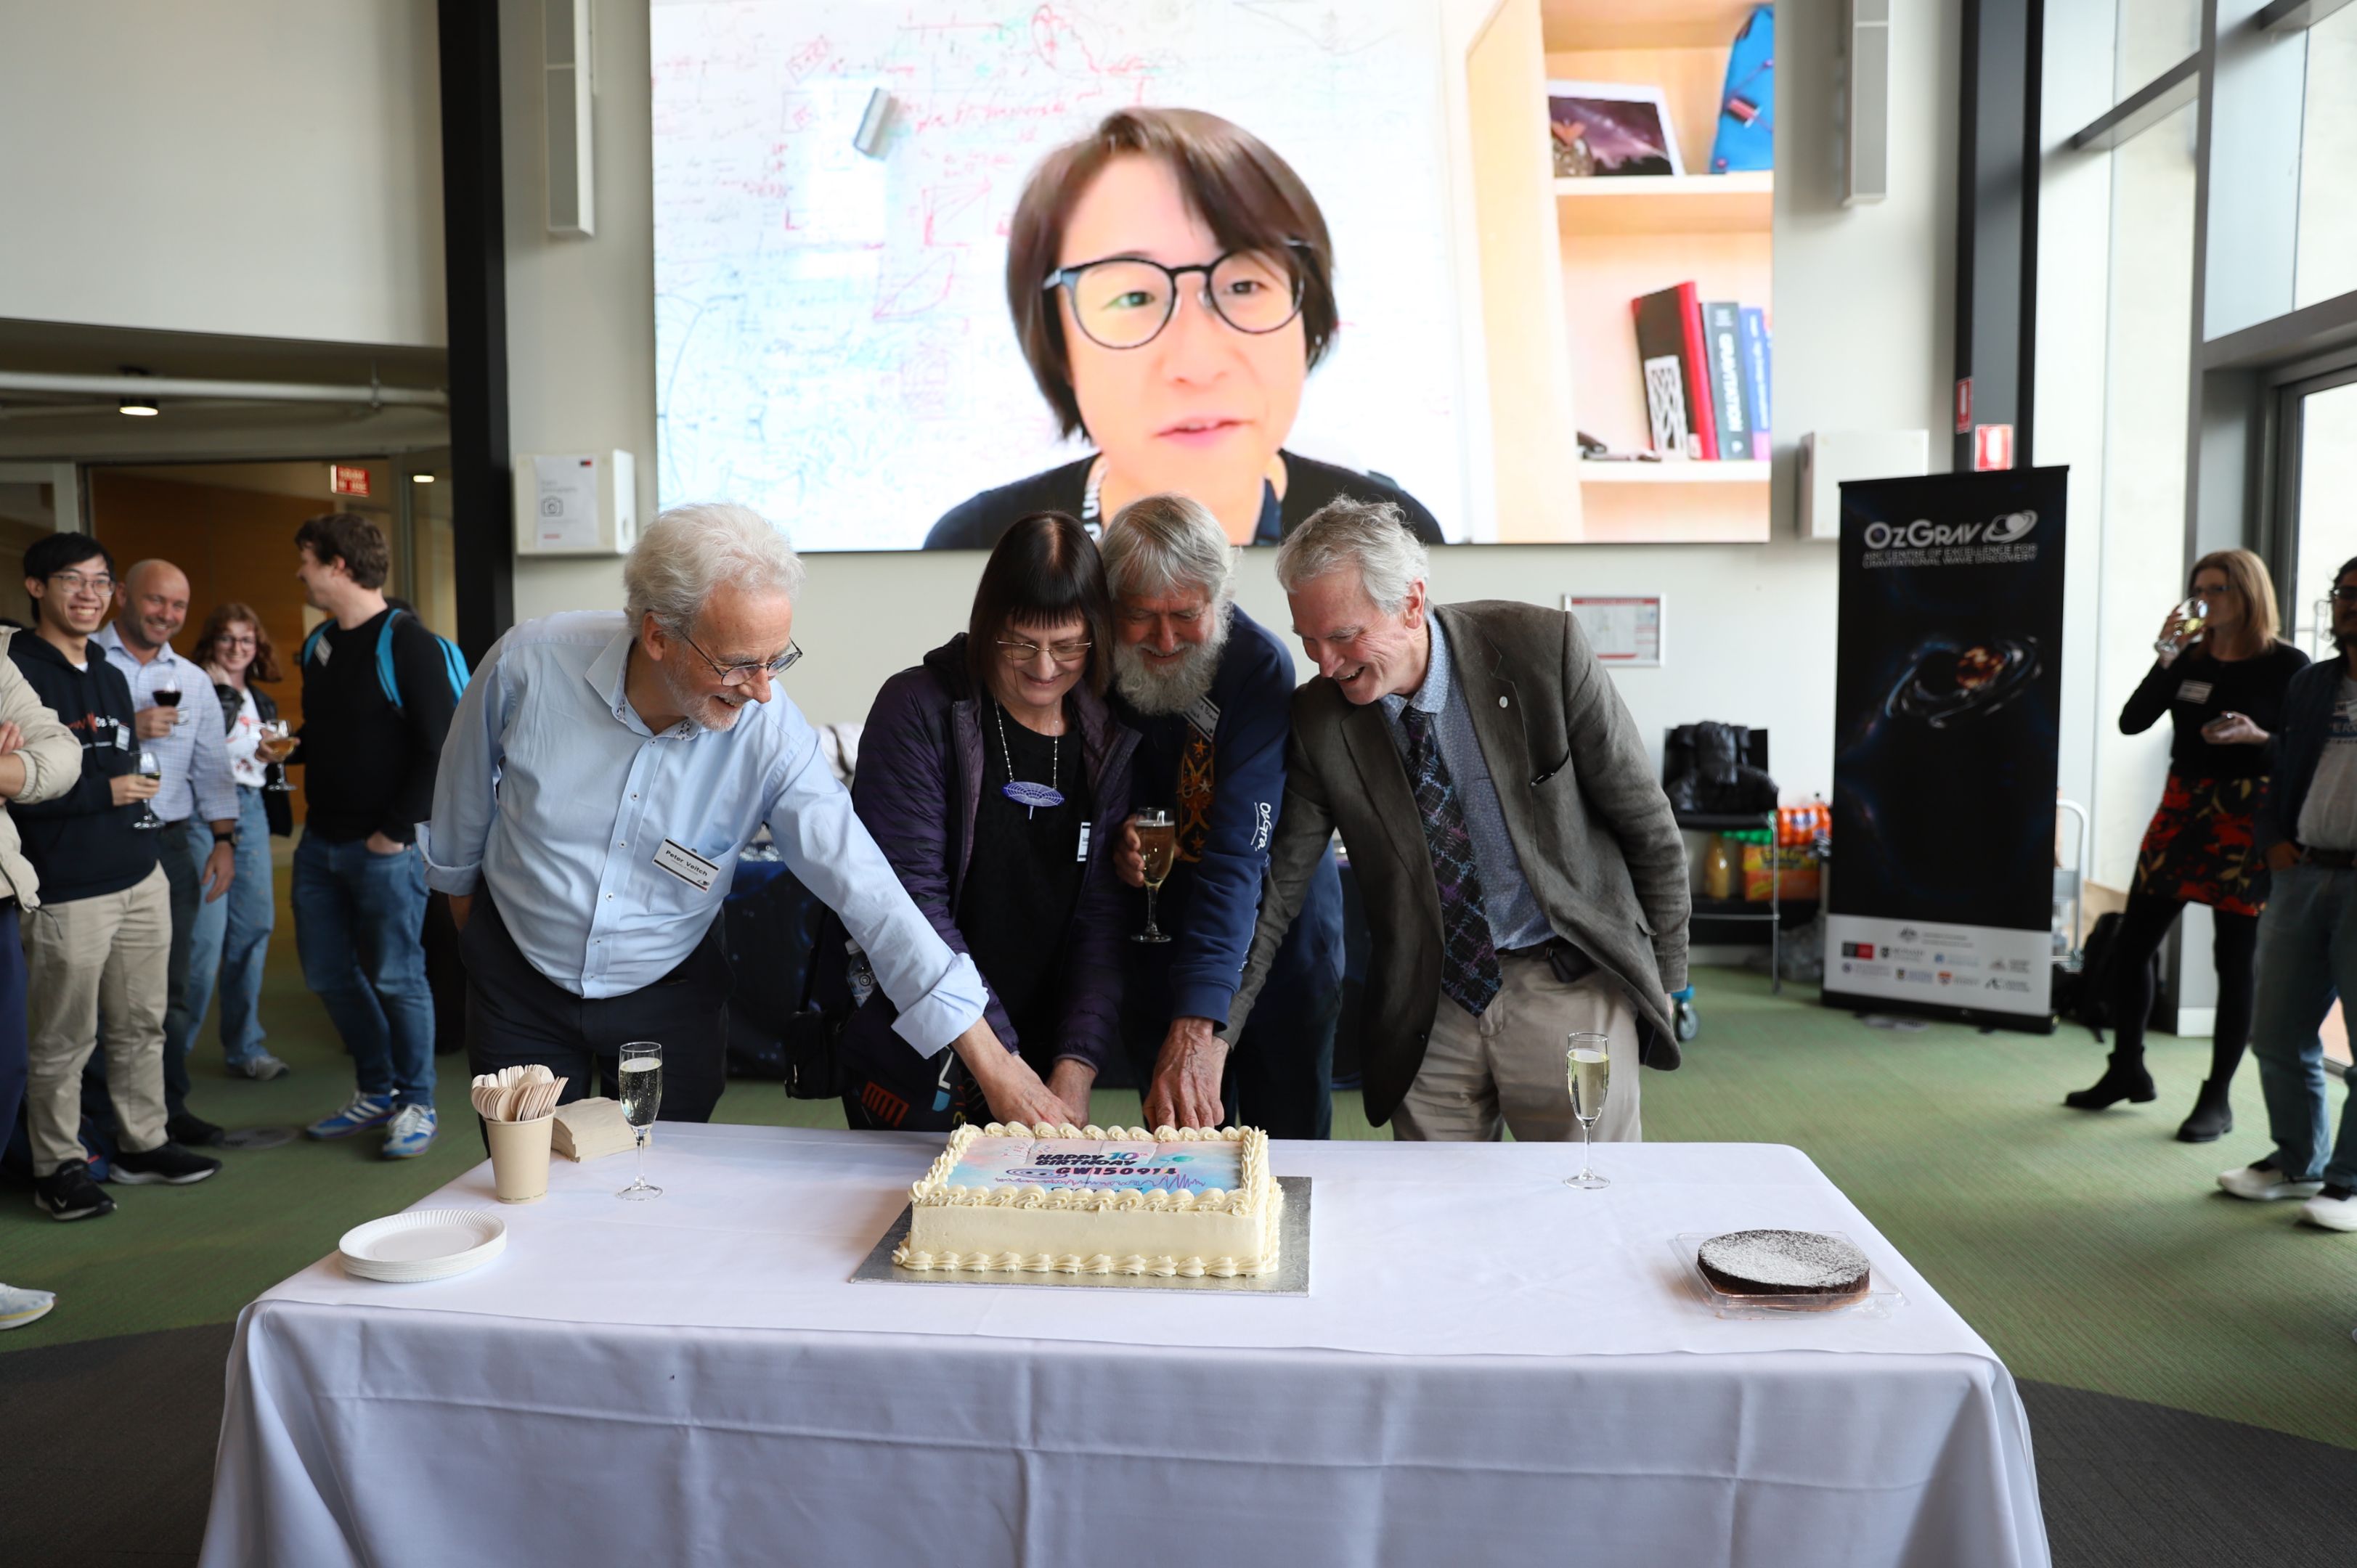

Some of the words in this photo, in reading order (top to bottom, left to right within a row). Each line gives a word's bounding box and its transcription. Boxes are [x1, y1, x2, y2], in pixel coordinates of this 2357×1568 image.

[1944, 544, 2011, 556] EXCELLENCE
[1942, 555, 1974, 565] WAVE
[1975, 552, 2036, 564] DISCOVERY
[666, 849, 683, 862] Peter
[685, 861, 708, 876] Veitch
[1055, 1167, 1178, 1175] GW150914
